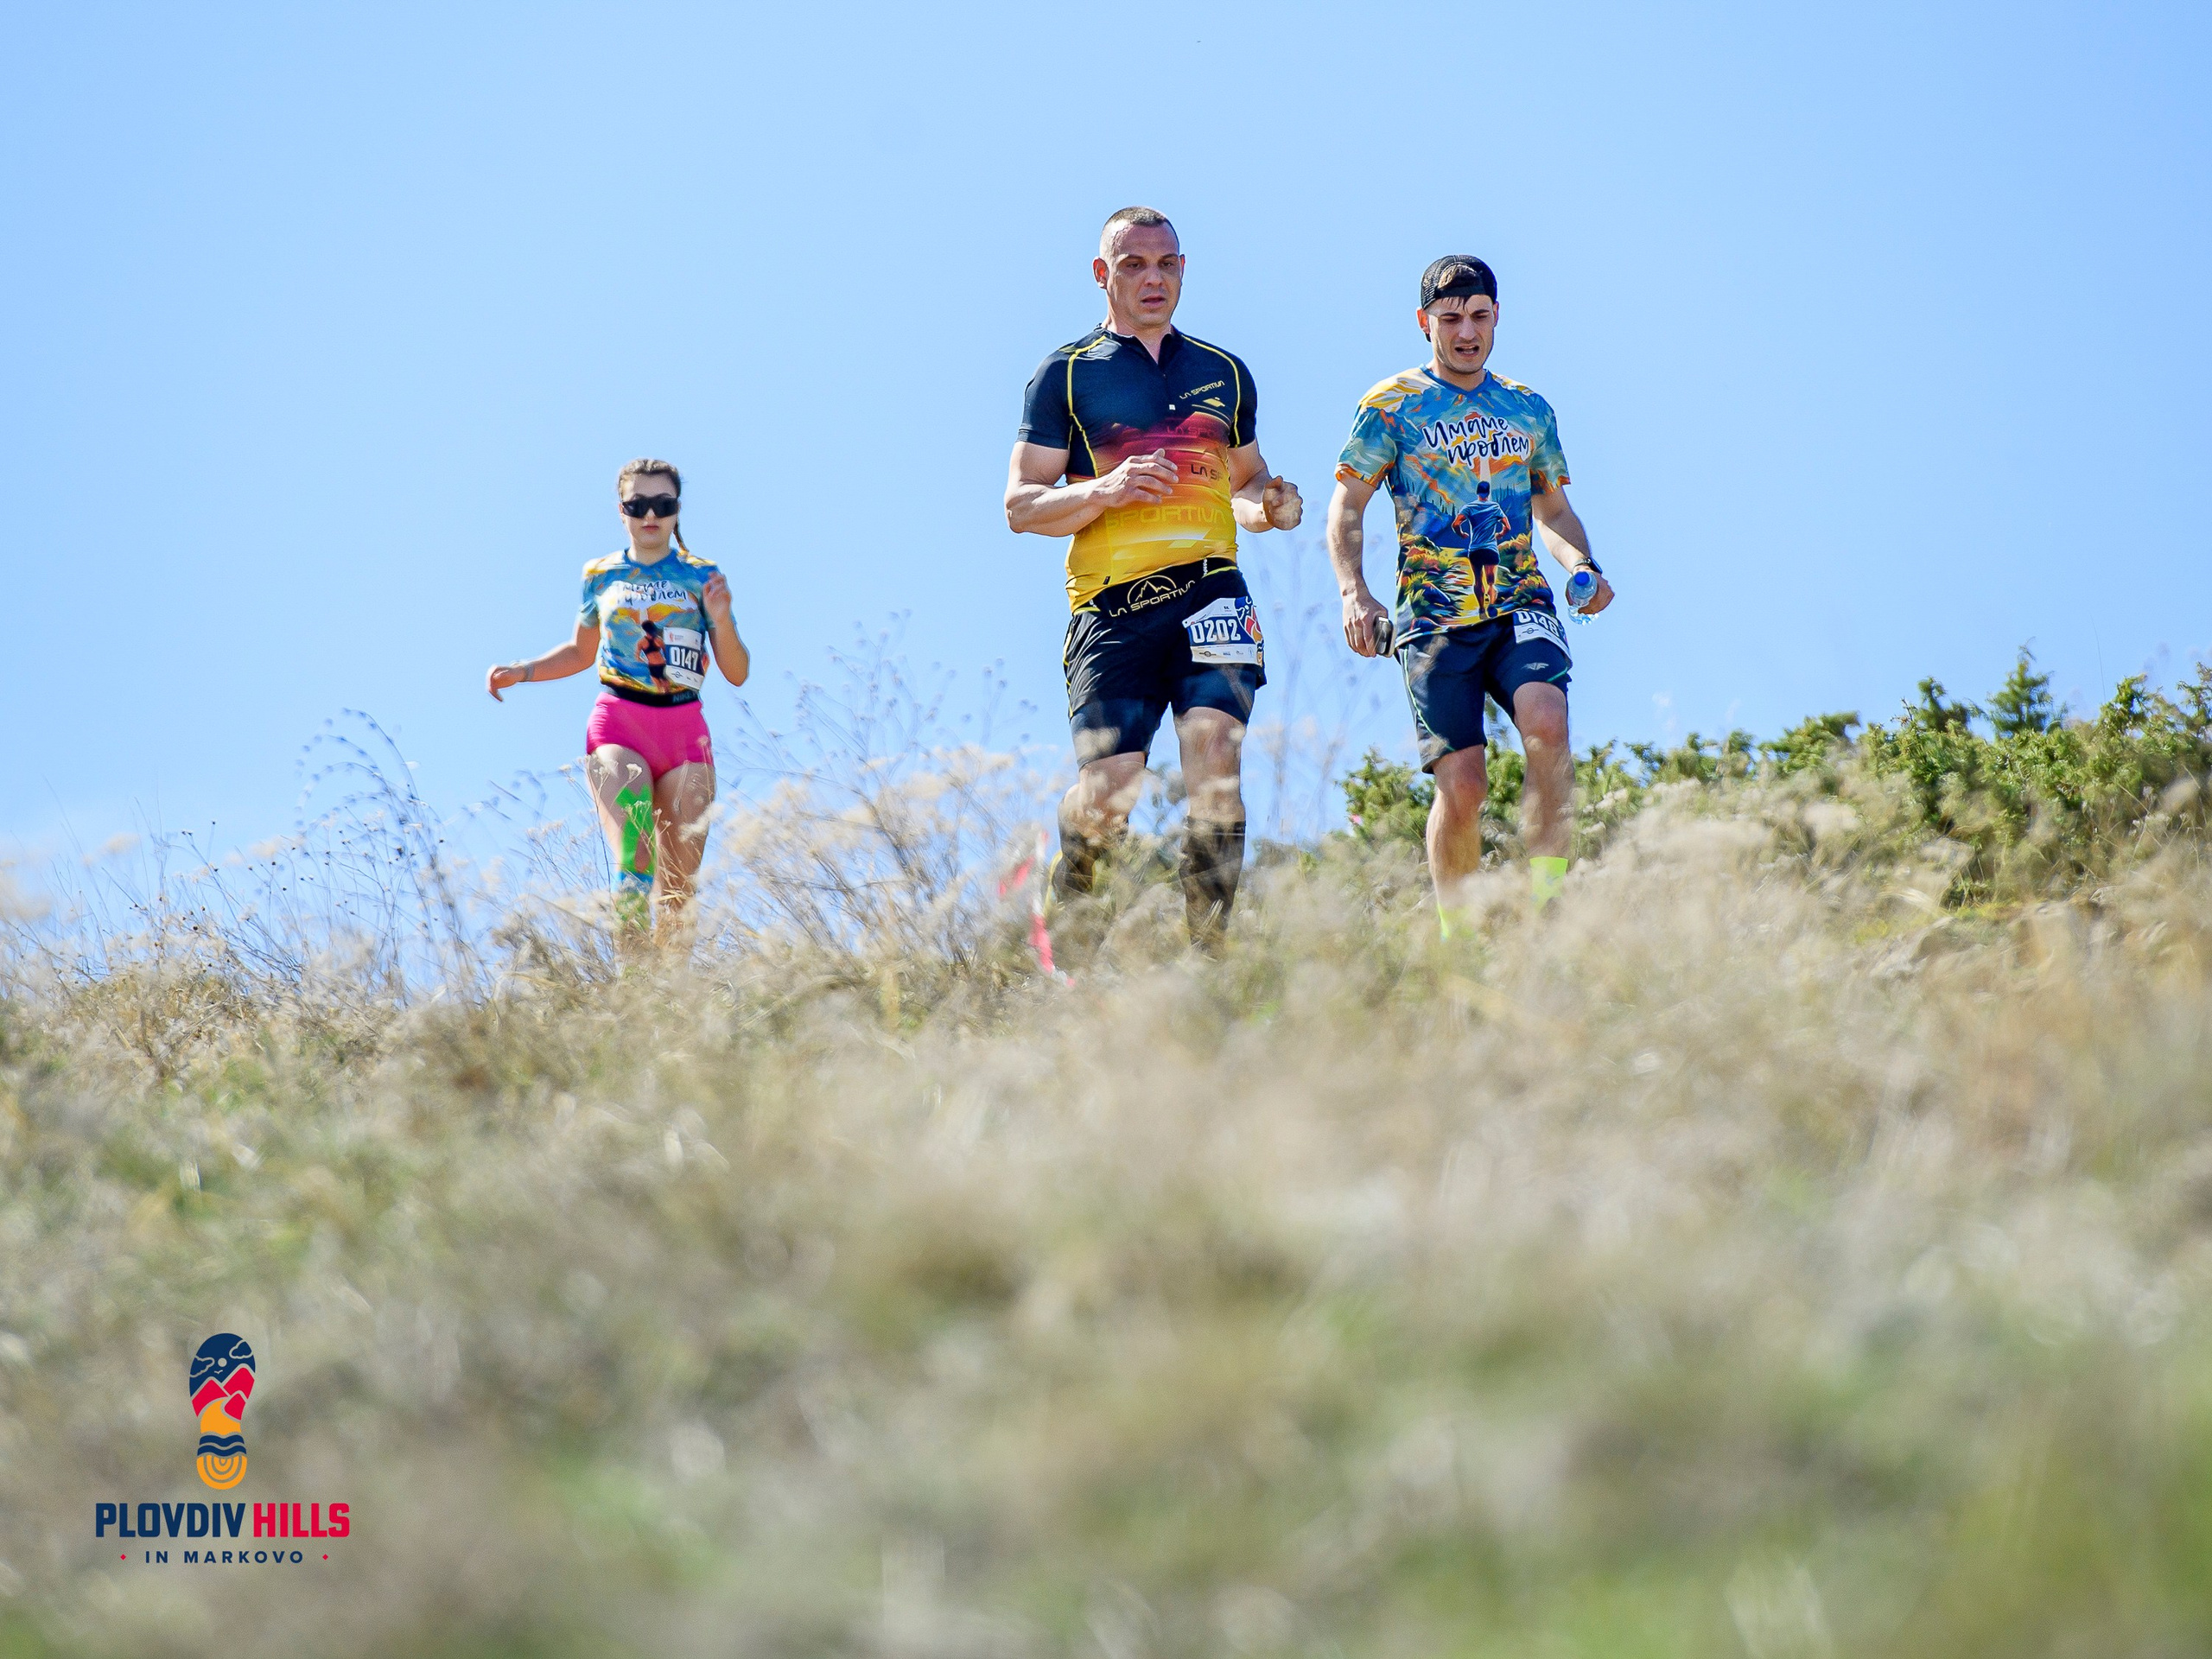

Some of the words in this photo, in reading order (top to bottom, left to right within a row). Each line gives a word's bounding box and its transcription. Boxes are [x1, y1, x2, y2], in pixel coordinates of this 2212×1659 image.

[1191, 380, 1225, 396] SPORTIVA
[1422, 416, 1509, 448] Имаме
[1447, 431, 1529, 467] проблем
[1191, 463, 1208, 478] LA
[1109, 607, 1128, 617] LA
[1130, 580, 1196, 612] SPORTIVA
[1191, 619, 1242, 644] 0202
[670, 645, 699, 671] 0147
